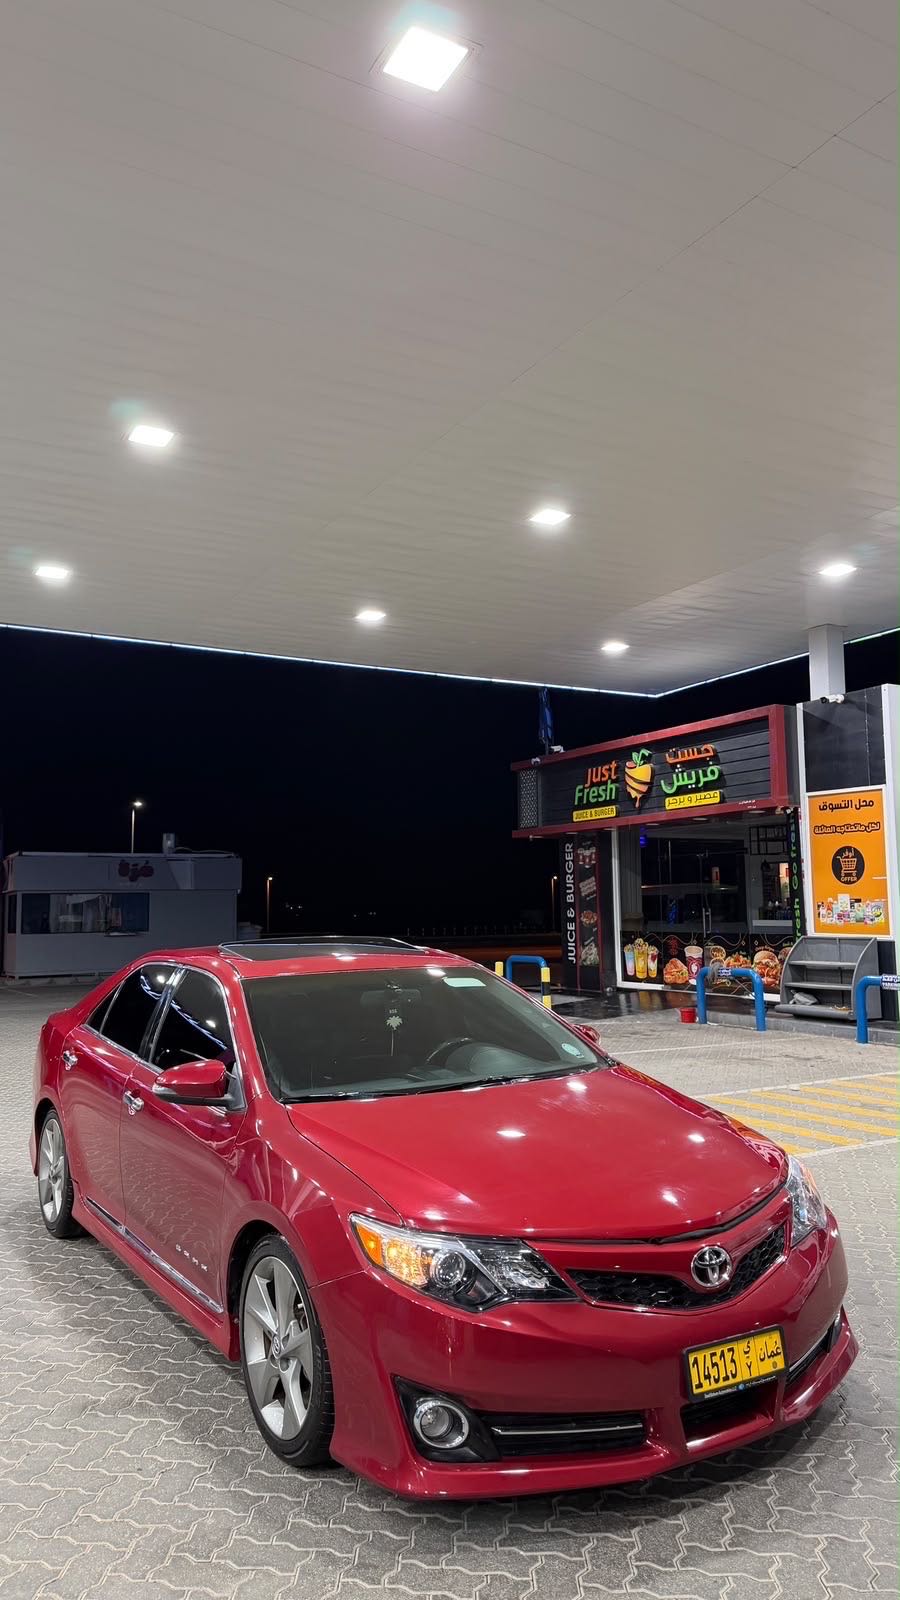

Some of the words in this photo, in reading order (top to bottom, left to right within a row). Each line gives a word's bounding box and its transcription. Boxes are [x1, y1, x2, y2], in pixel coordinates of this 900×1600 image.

[665, 744, 714, 763] جست
[660, 762, 719, 793] فريش
[574, 780, 616, 805] Fresh
[694, 792, 718, 804] عصير
[667, 797, 686, 807] برجر
[819, 799, 853, 812] التسوق
[854, 799, 874, 810] محل
[575, 811, 588, 819] JUICE
[594, 807, 615, 817] BURGER
[866, 822, 880, 833] لكل
[565, 843, 575, 902] BURGER
[566, 909, 575, 918] &
[567, 922, 576, 964] JUICE
[692, 1347, 738, 1390] 14513
[746, 1361, 753, 1377] Y
